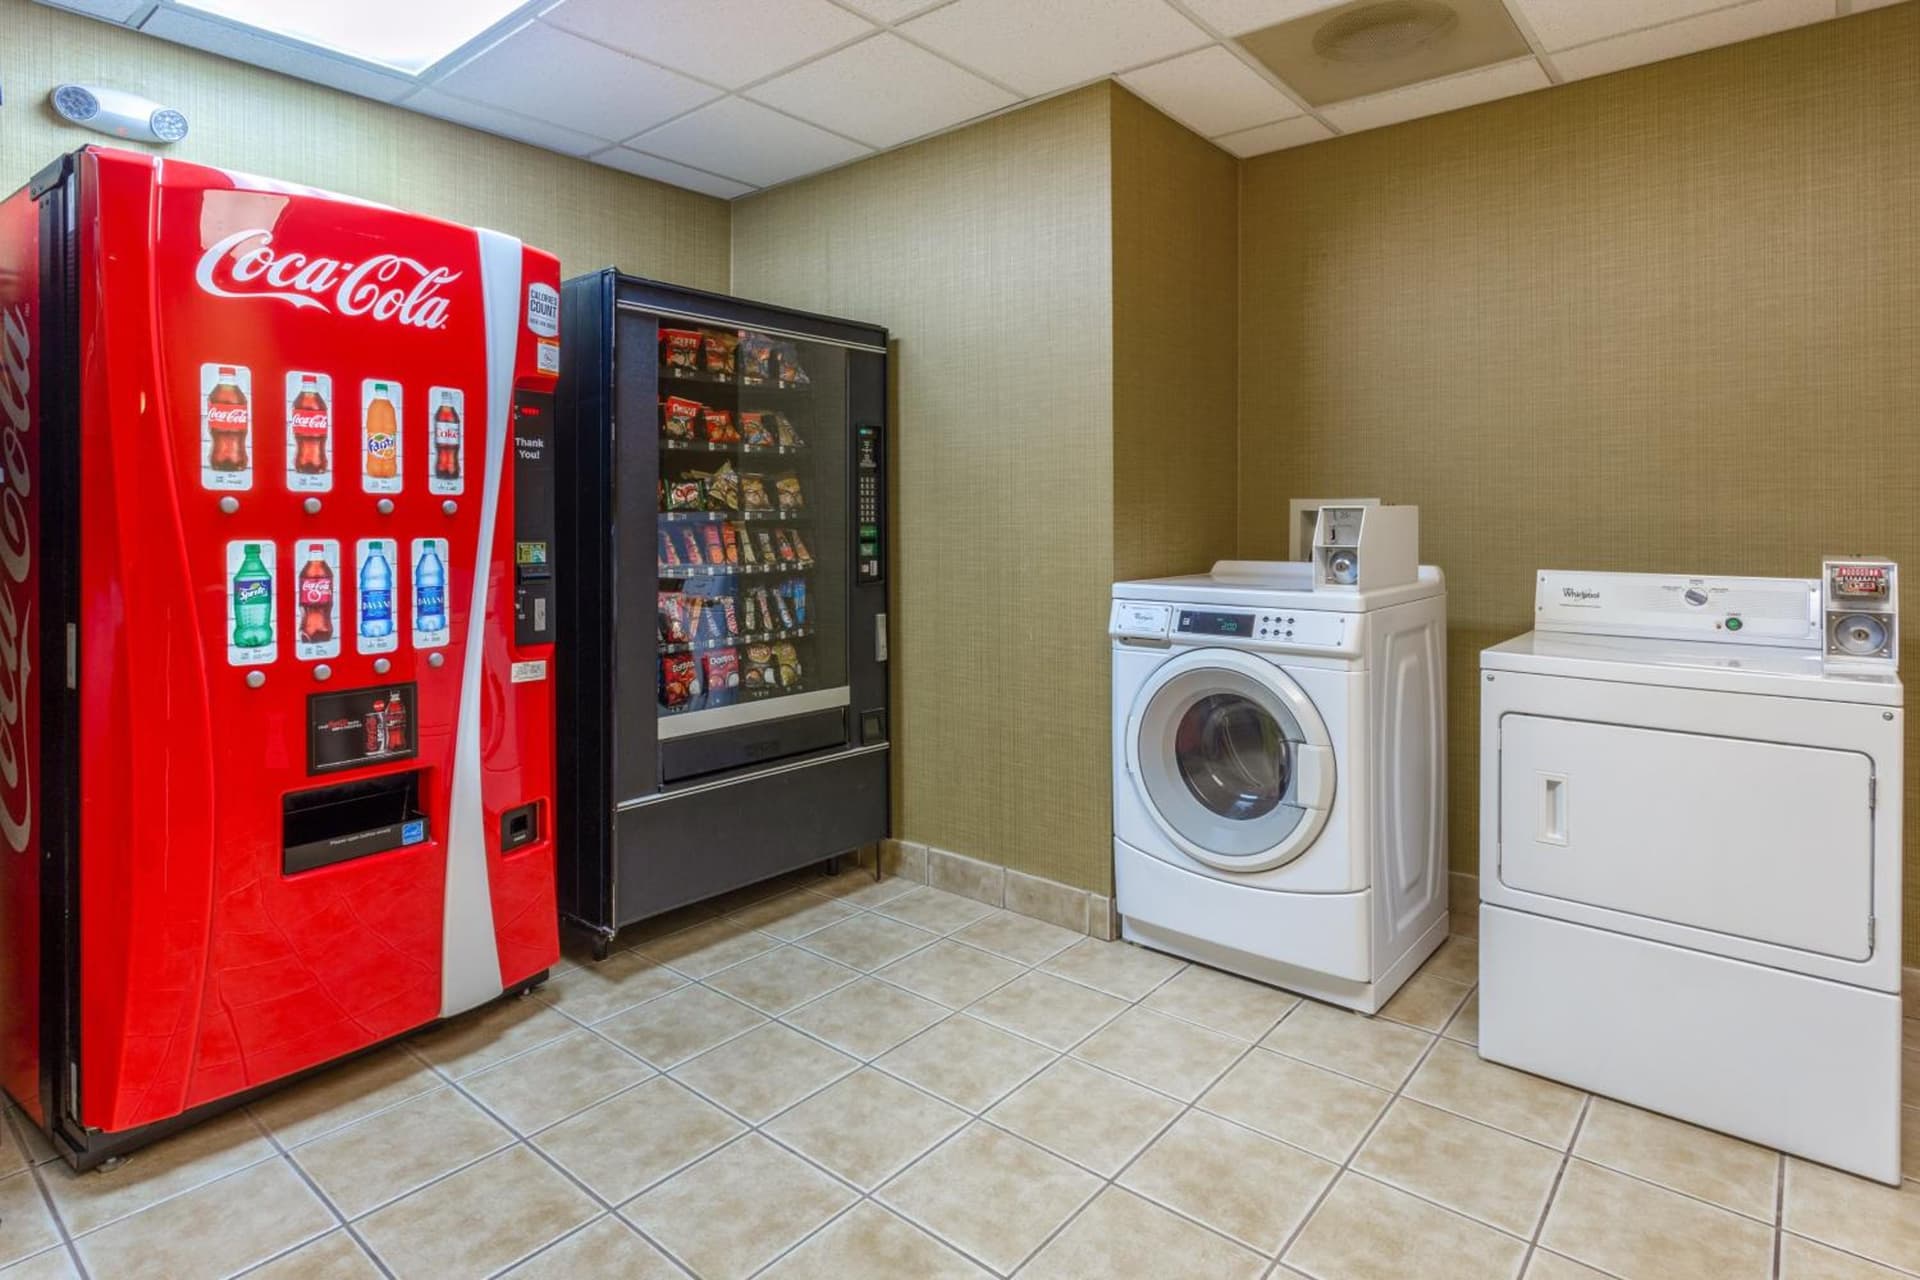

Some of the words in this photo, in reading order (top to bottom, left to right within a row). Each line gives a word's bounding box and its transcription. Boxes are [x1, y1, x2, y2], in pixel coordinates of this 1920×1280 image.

[196, 229, 463, 329] Coca-Cola
[529, 299, 558, 318] COUNT
[208, 407, 248, 424] Coca-Cola
[292, 413, 328, 429] Coca-Cola
[515, 437, 544, 448] Thank
[519, 450, 540, 460] You!
[1563, 587, 1600, 601] Whirlpool
